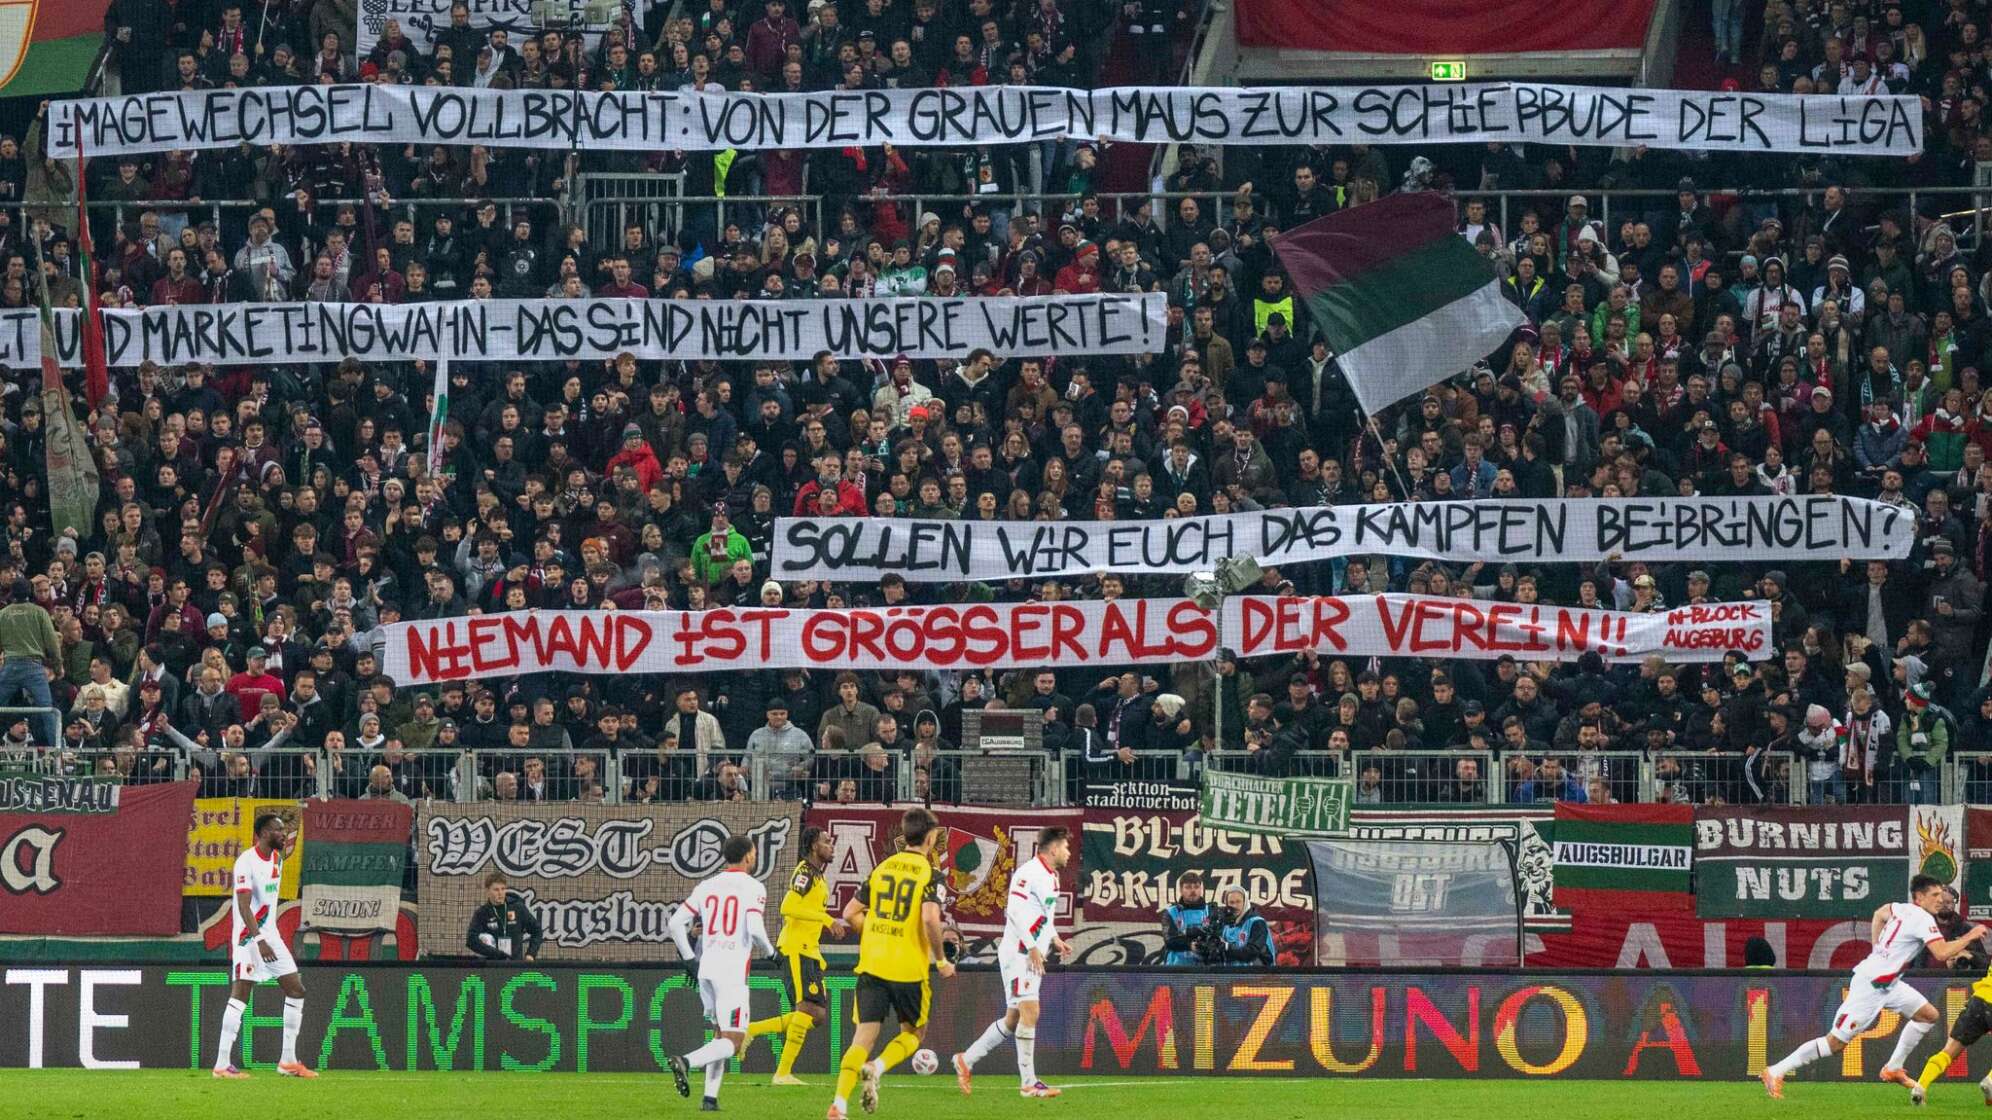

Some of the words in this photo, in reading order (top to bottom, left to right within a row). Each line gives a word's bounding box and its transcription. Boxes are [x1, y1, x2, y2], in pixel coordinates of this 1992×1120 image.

[699, 97, 785, 146] VON
[805, 92, 893, 144] DER
[908, 88, 1095, 141] GRAUEN
[1112, 89, 1231, 142] MAUS
[1238, 91, 1342, 138] ZUR
[1679, 97, 1772, 148] DER
[0, 312, 37, 362] T
[824, 300, 968, 356] UNSERE
[782, 521, 972, 576] SOLLEN
[1108, 520, 1234, 568] EUCH
[1261, 510, 1342, 557] DAS
[1355, 502, 1567, 557] KÄMPFEN
[801, 604, 1088, 667] GRÖSSER
[1099, 600, 1217, 658] ALS
[1242, 597, 1350, 655] DER
[1662, 628, 1764, 652] AUGSBURG
[1208, 775, 1285, 795] DURCHHALTEN
[313, 814, 401, 830] WEITER
[1209, 787, 1288, 827] TETE!
[1696, 818, 1904, 851] BURNING
[1557, 842, 1687, 869] AUGSBULGAR
[875, 873, 918, 922] 28
[1735, 865, 1871, 901] NUTS
[312, 898, 383, 919] SIMON!
[705, 894, 739, 937] 20
[1081, 985, 1589, 1075] MIZUNO
